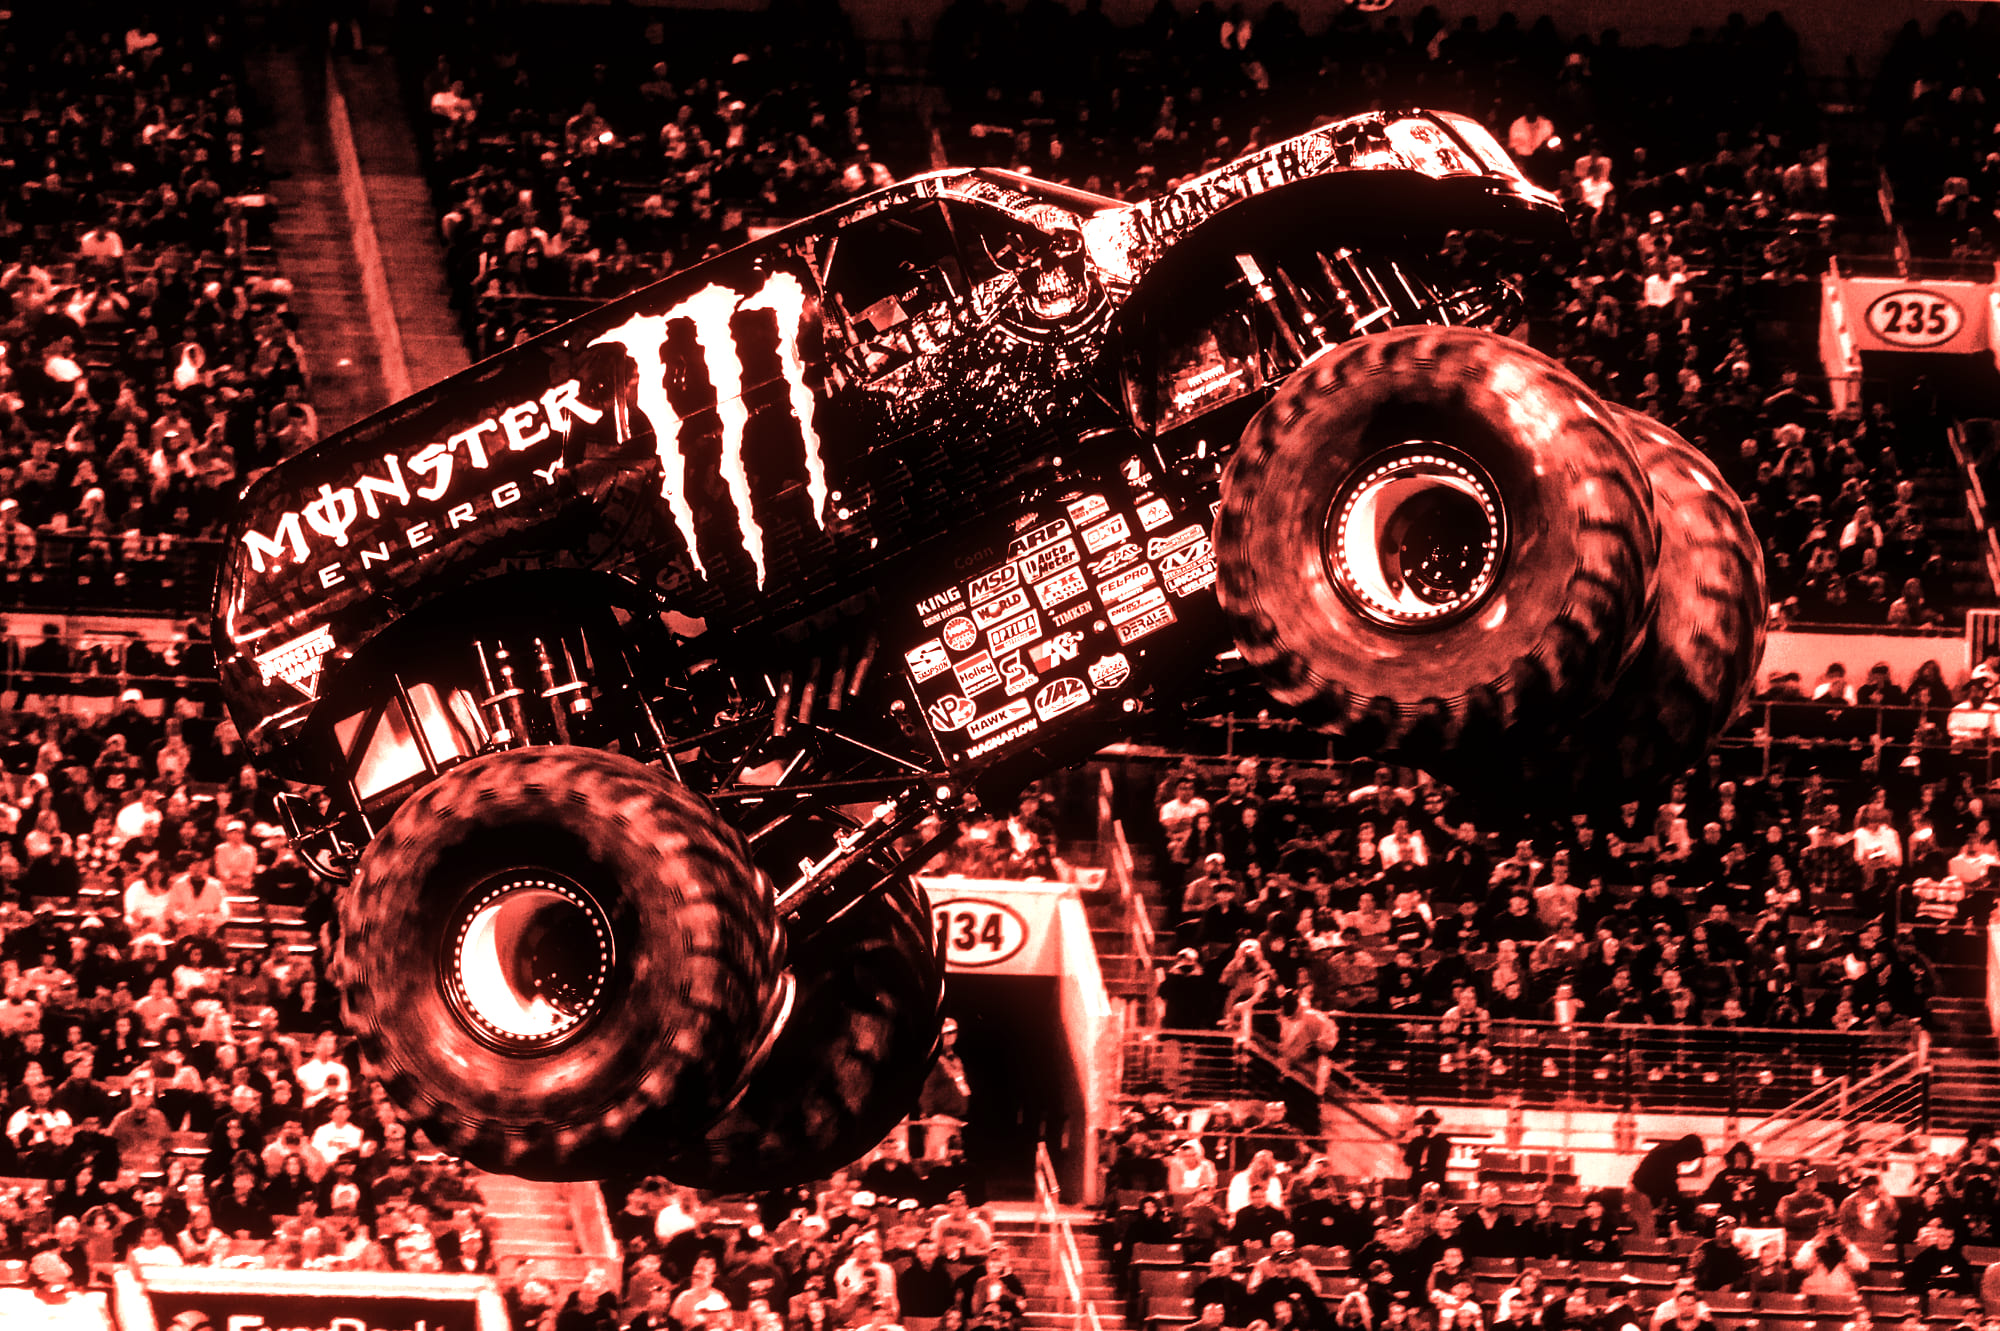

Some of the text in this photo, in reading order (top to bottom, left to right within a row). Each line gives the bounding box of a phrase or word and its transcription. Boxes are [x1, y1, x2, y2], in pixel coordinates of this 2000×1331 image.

[1884, 301, 1946, 335] 235
[241, 379, 603, 572] MONSTER
[318, 456, 565, 589] ENERGY
[1007, 520, 1066, 560] ARP
[1037, 545, 1067, 563] Auto
[954, 546, 994, 569] Coan
[1039, 551, 1076, 576] Meter
[971, 565, 1015, 599] MSD
[1167, 561, 1214, 590] LINCOLN
[916, 586, 961, 617] KING
[1052, 601, 1093, 627] TIMKEN
[990, 614, 1037, 647] OPTIMA
[1122, 607, 1169, 636] DERALE
[258, 634, 336, 680] MONSTER
[959, 662, 994, 684] Holley
[1037, 678, 1083, 709] JAZ
[930, 696, 958, 729] VP
[970, 710, 1008, 735] HAWK
[966, 718, 1038, 759] MAGNAFLOW
